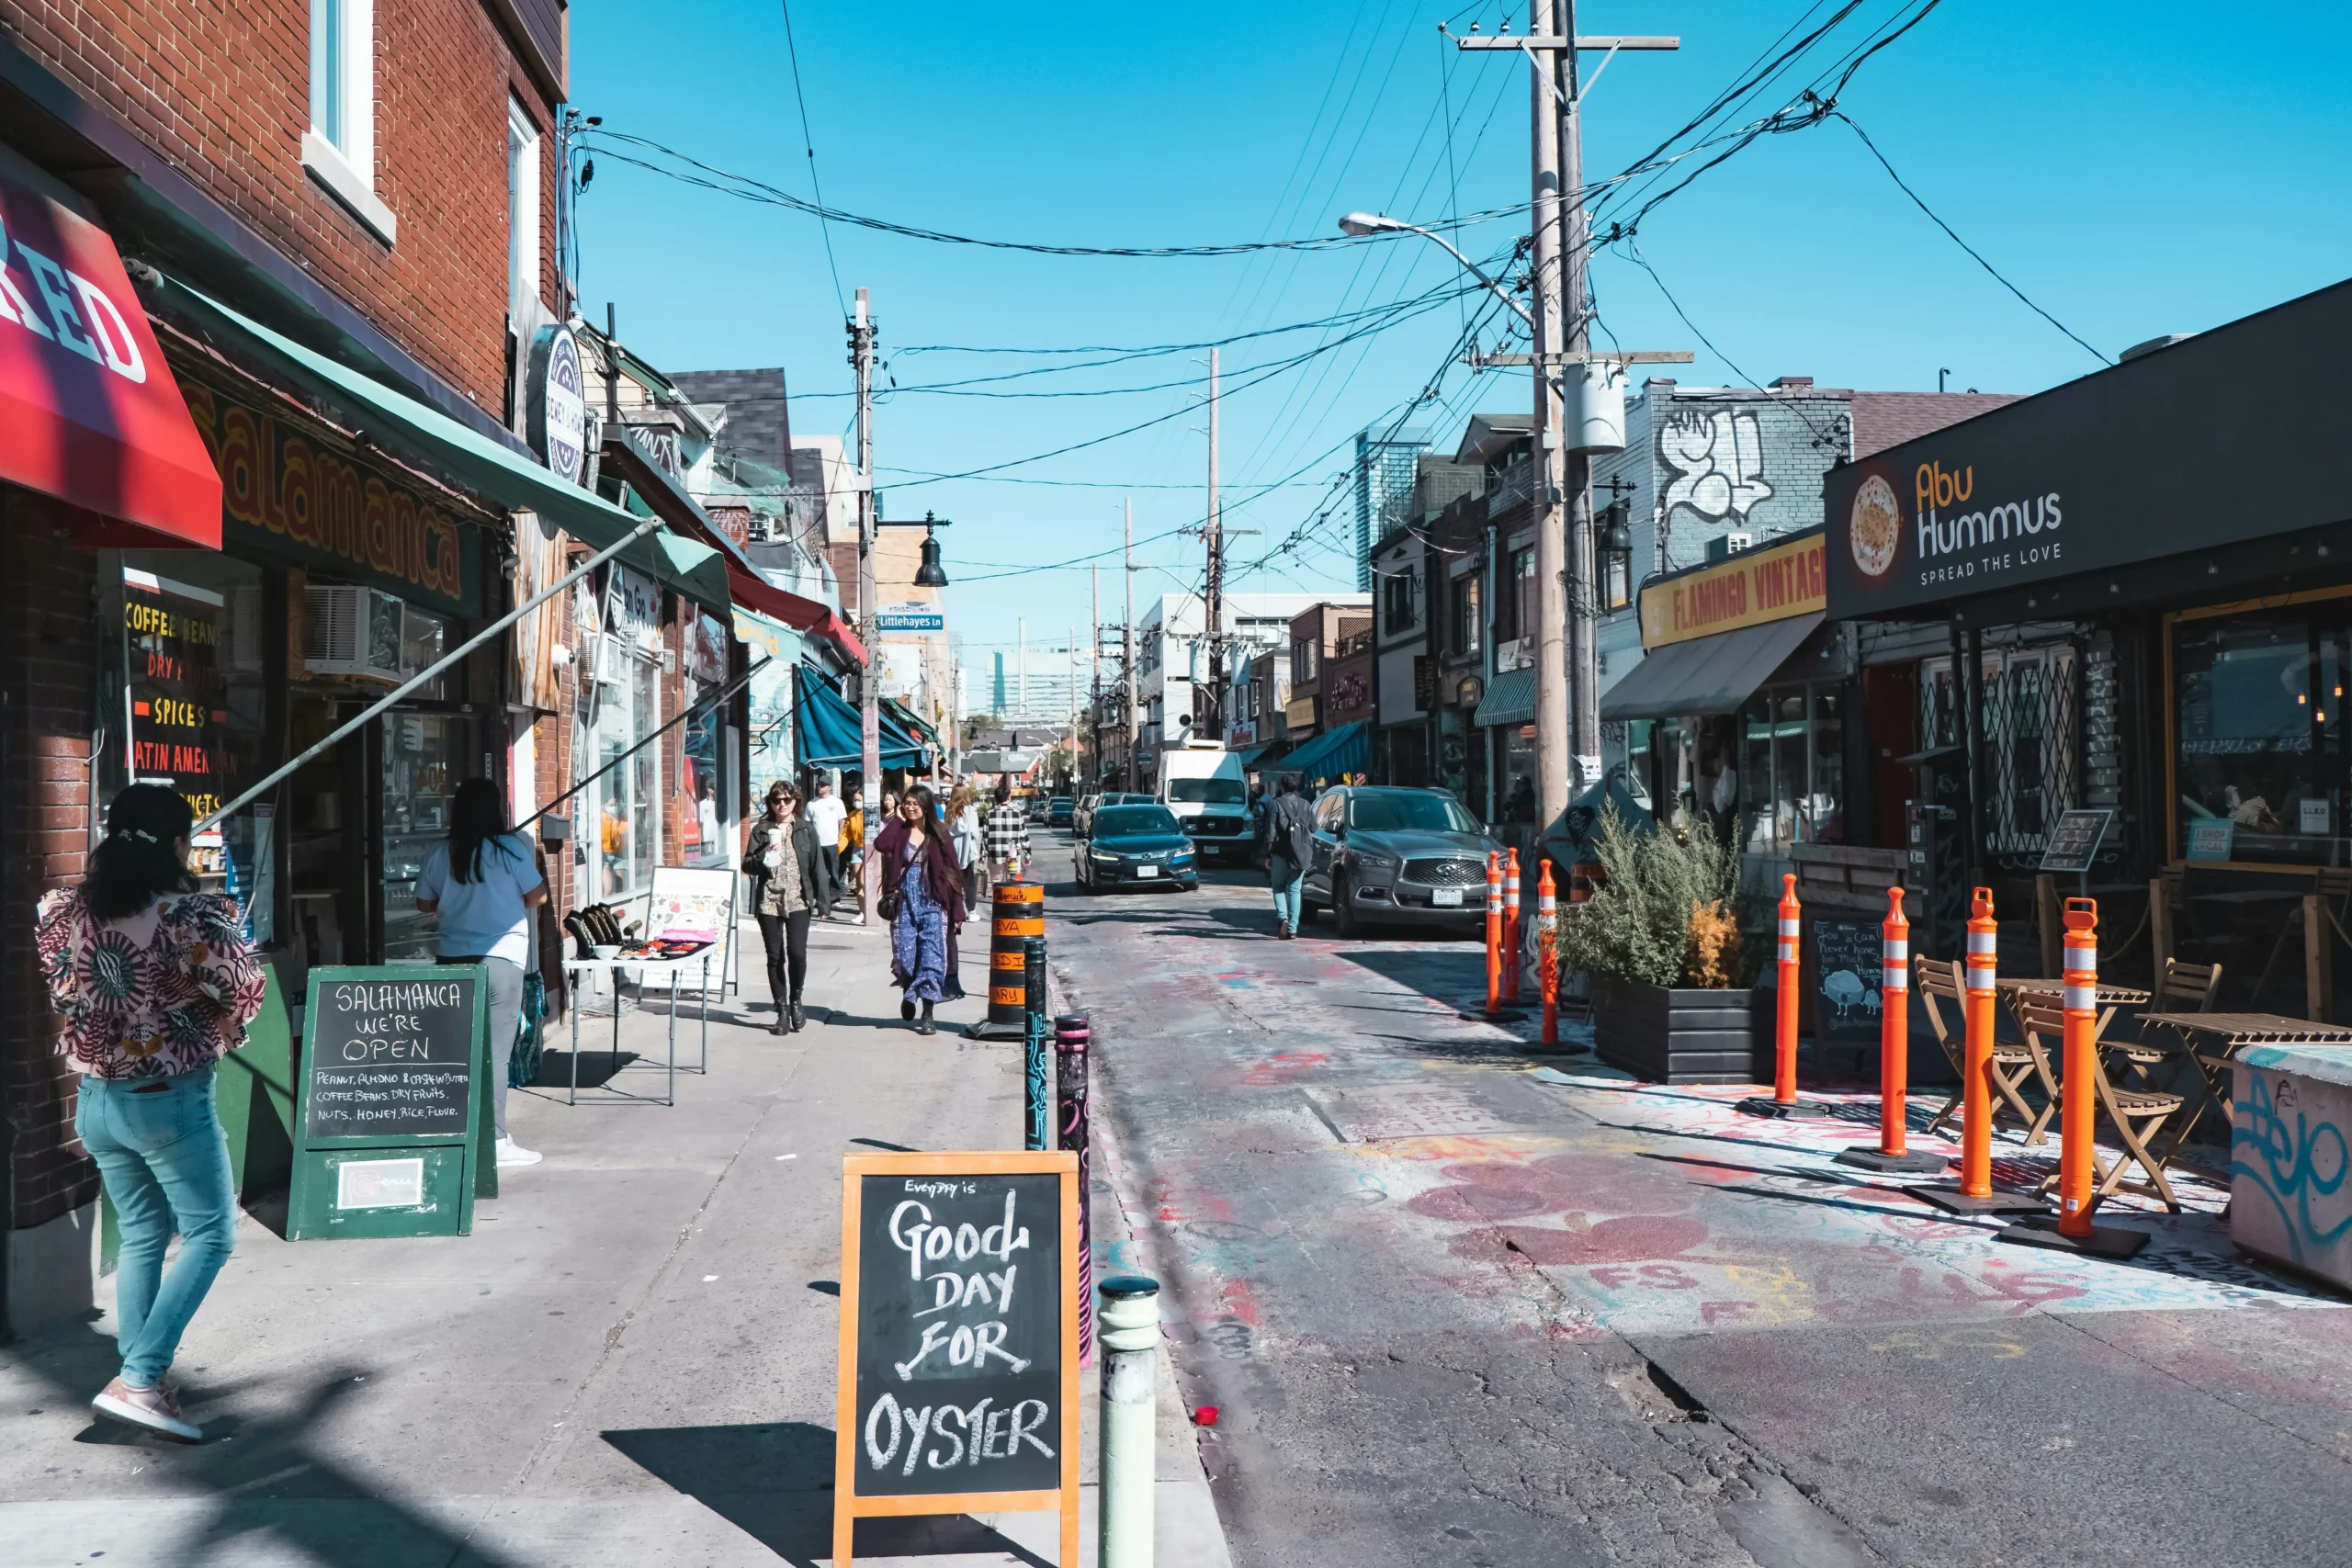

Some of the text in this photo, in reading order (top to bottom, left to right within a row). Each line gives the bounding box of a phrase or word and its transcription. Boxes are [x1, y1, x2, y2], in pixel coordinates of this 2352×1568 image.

[1916, 459, 1973, 514] Abu
[1917, 491, 2063, 558] Hummus
[1921, 542, 2063, 587] SPREAD THE LOVE
[1672, 570, 1747, 633] FLAMINGO
[125, 602, 222, 648] COFFEE BEANS
[880, 615, 941, 628] Littlehayes Ln
[148, 652, 174, 679] DRY
[155, 697, 206, 728] SPICES
[2202, 829, 2226, 839] SHOP
[1853, 943, 1876, 954] have
[336, 983, 460, 1012] SALAMANCA
[356, 1013, 423, 1034] WE'RE
[343, 1036, 430, 1061] OPEN
[402, 1072, 410, 1084] &
[316, 1091, 354, 1102] COFFEE
[390, 1088, 413, 1100] DRY
[962, 1180, 976, 1193] is
[888, 1188, 1030, 1280] Good
[912, 1264, 1017, 1318] DAY
[894, 1320, 1031, 1382] FOR
[865, 1392, 1057, 1477] OYSTER
